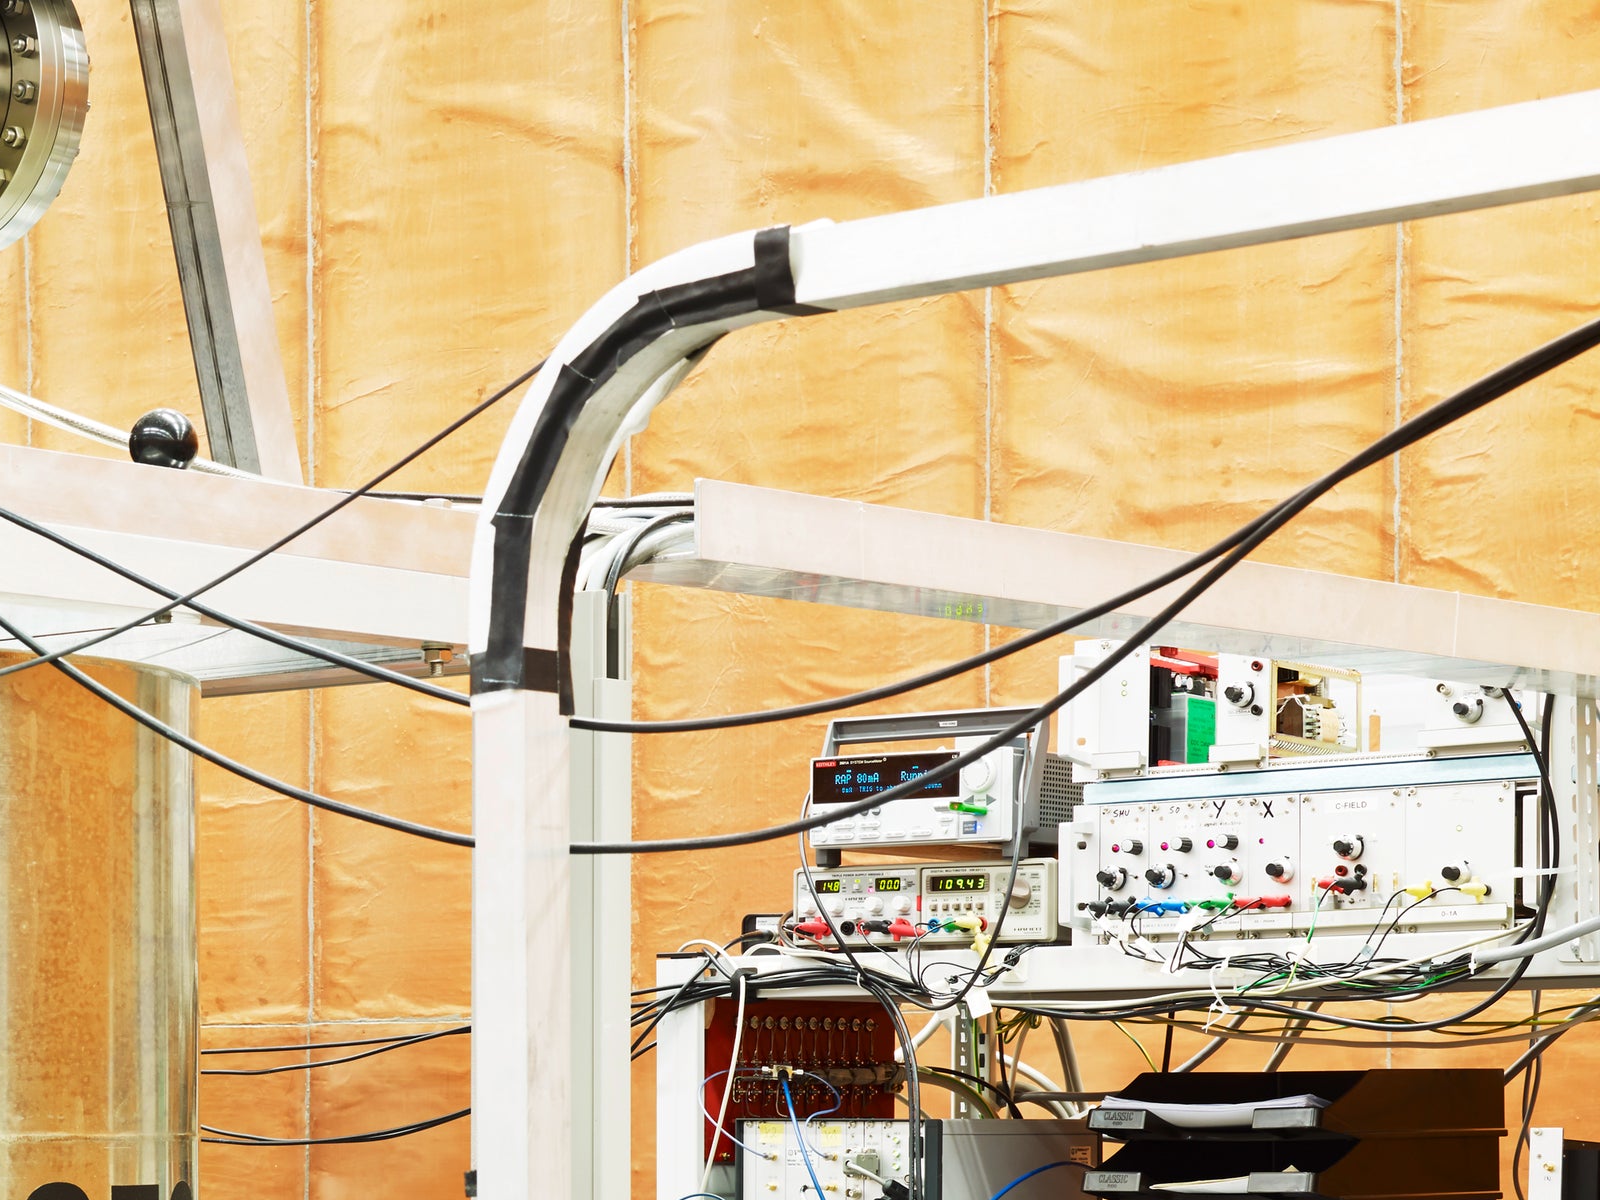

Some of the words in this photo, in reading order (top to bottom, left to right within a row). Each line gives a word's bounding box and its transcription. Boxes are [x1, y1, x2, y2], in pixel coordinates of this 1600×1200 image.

[834, 773, 853, 785] RAP
[856, 772, 880, 784] 80mA
[1212, 799, 1226, 819] Y
[1262, 800, 1274, 819] X
[1335, 801, 1368, 810] C-FIELD
[938, 878, 985, 890] 109.43
[1103, 1111, 1134, 1121] CLASSIC
[1098, 1174, 1129, 1184] CLASSIC
